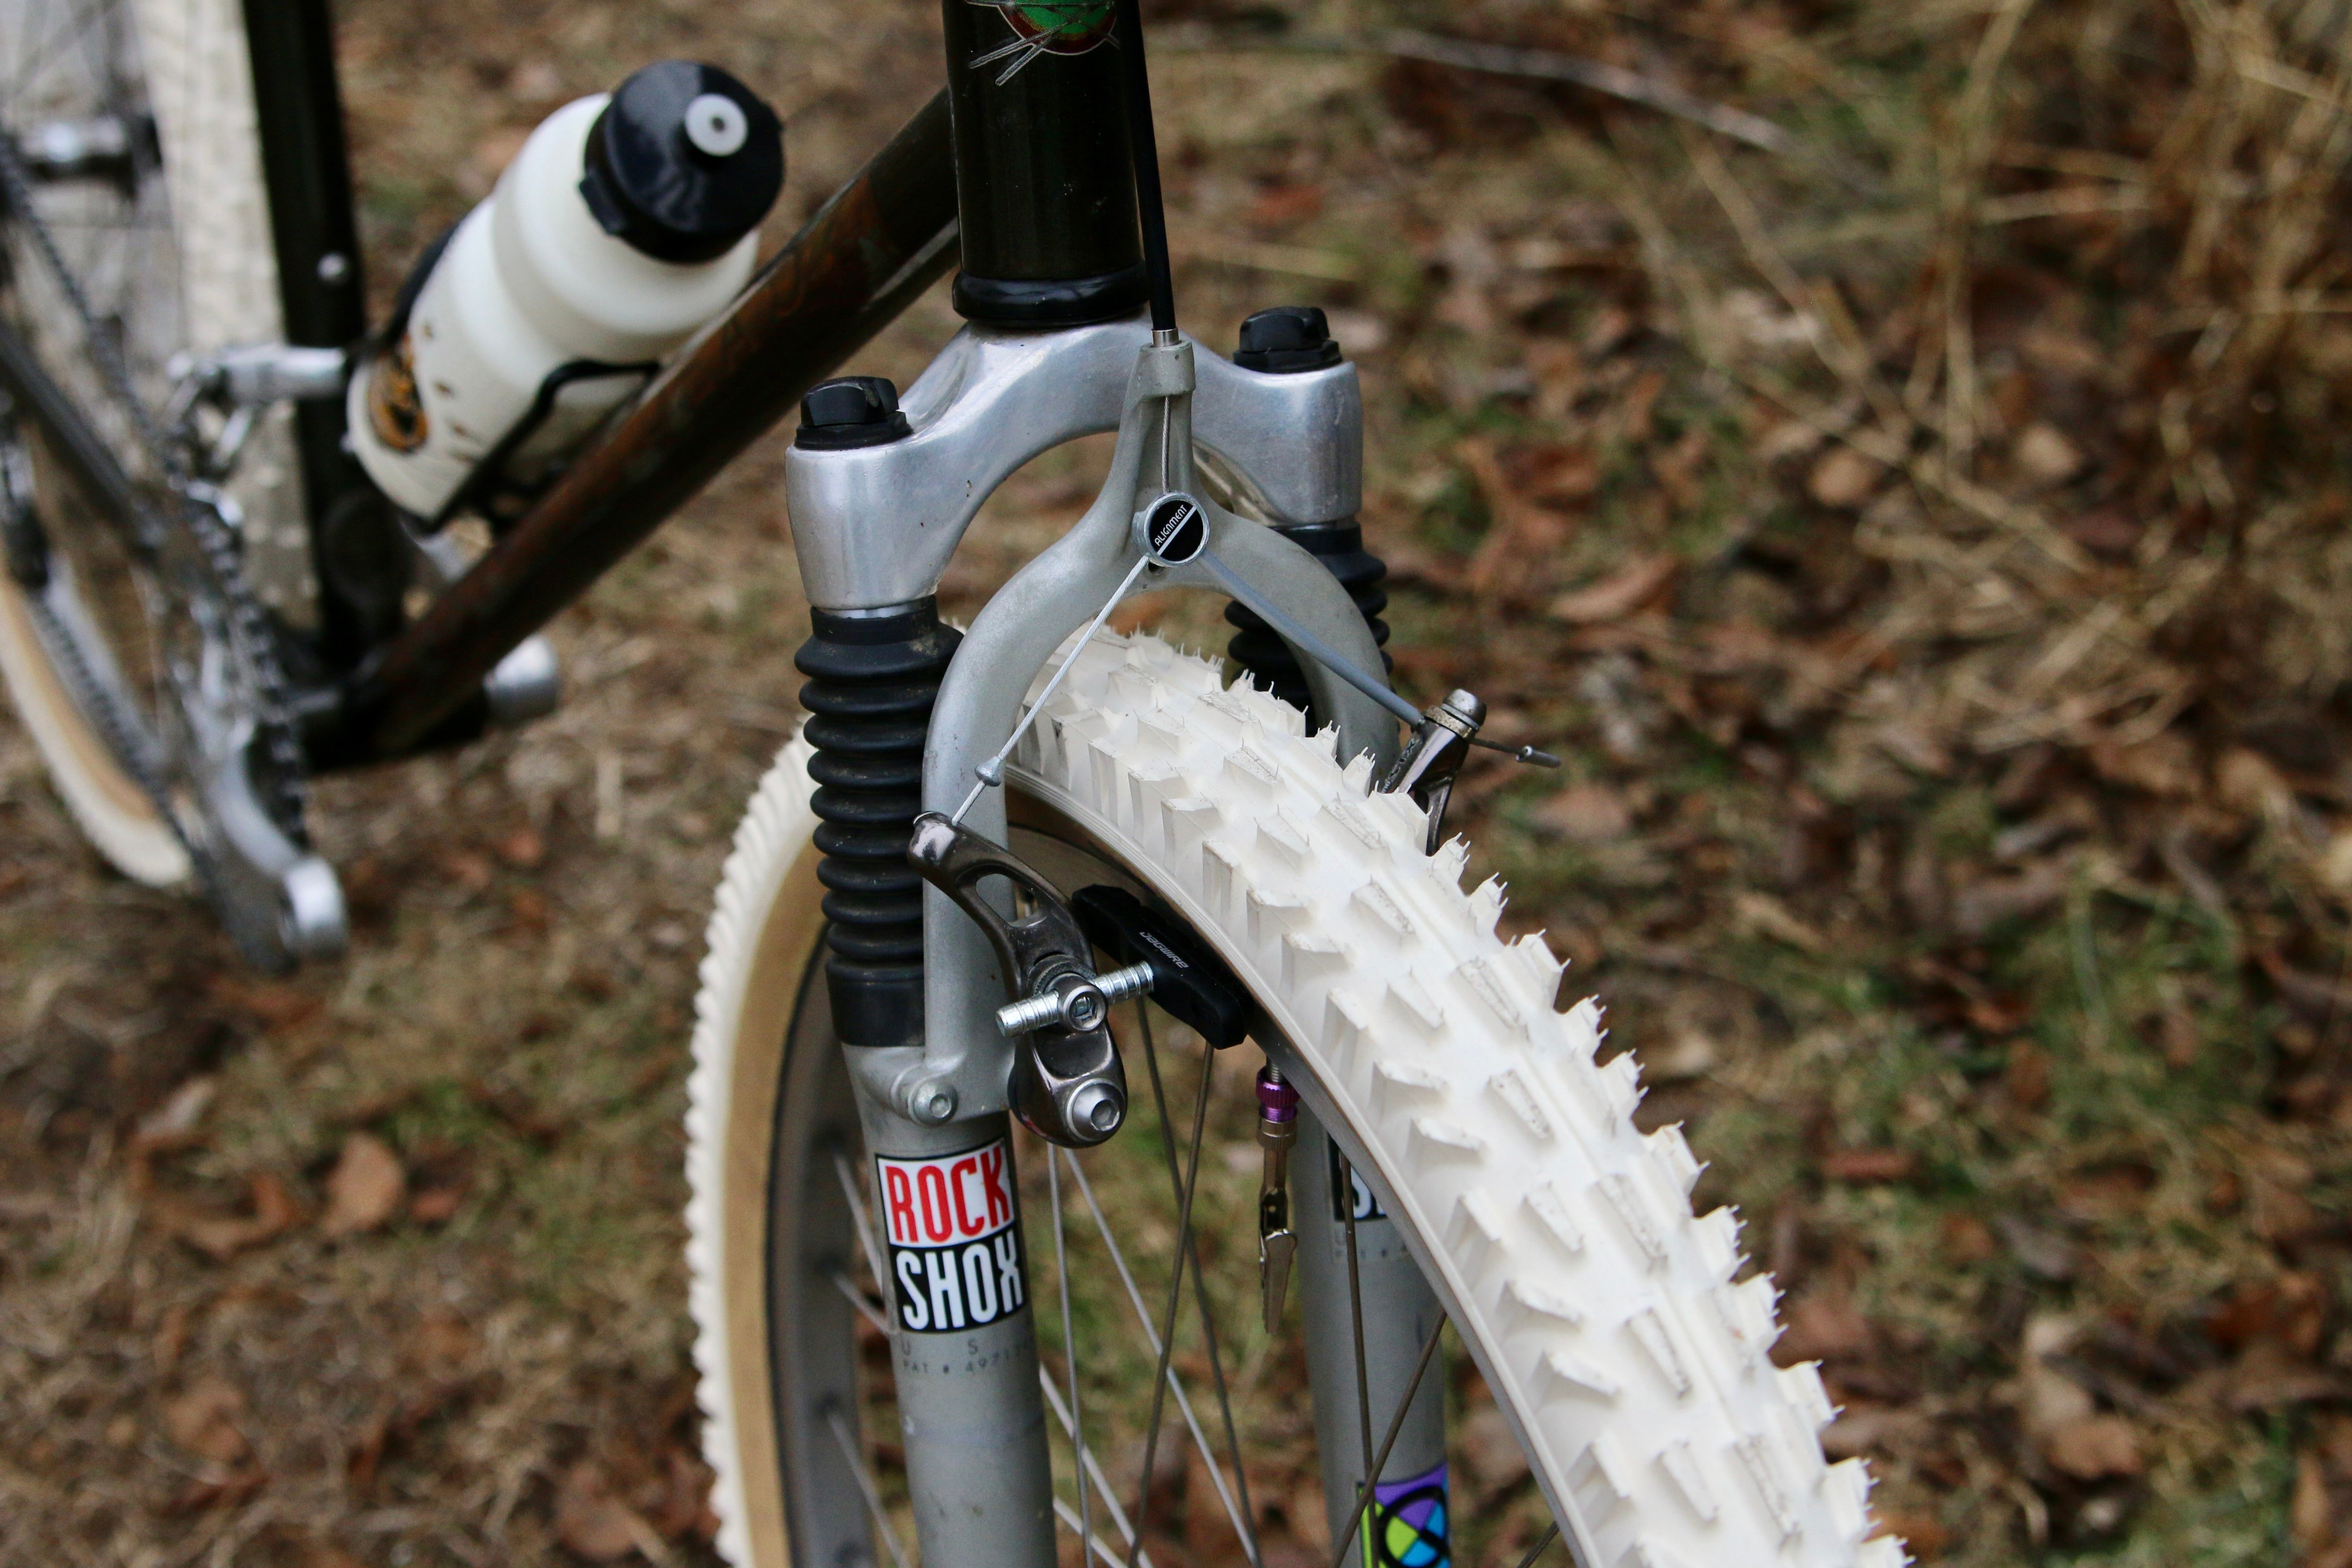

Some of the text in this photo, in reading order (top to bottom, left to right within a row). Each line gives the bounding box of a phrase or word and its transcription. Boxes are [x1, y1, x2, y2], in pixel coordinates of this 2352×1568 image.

[1155, 504, 1187, 546] ALIGNMENT
[1139, 932, 1189, 968] JAGWIRE
[885, 1145, 1009, 1243] ROCK
[896, 1229, 1023, 1330] SHOX
